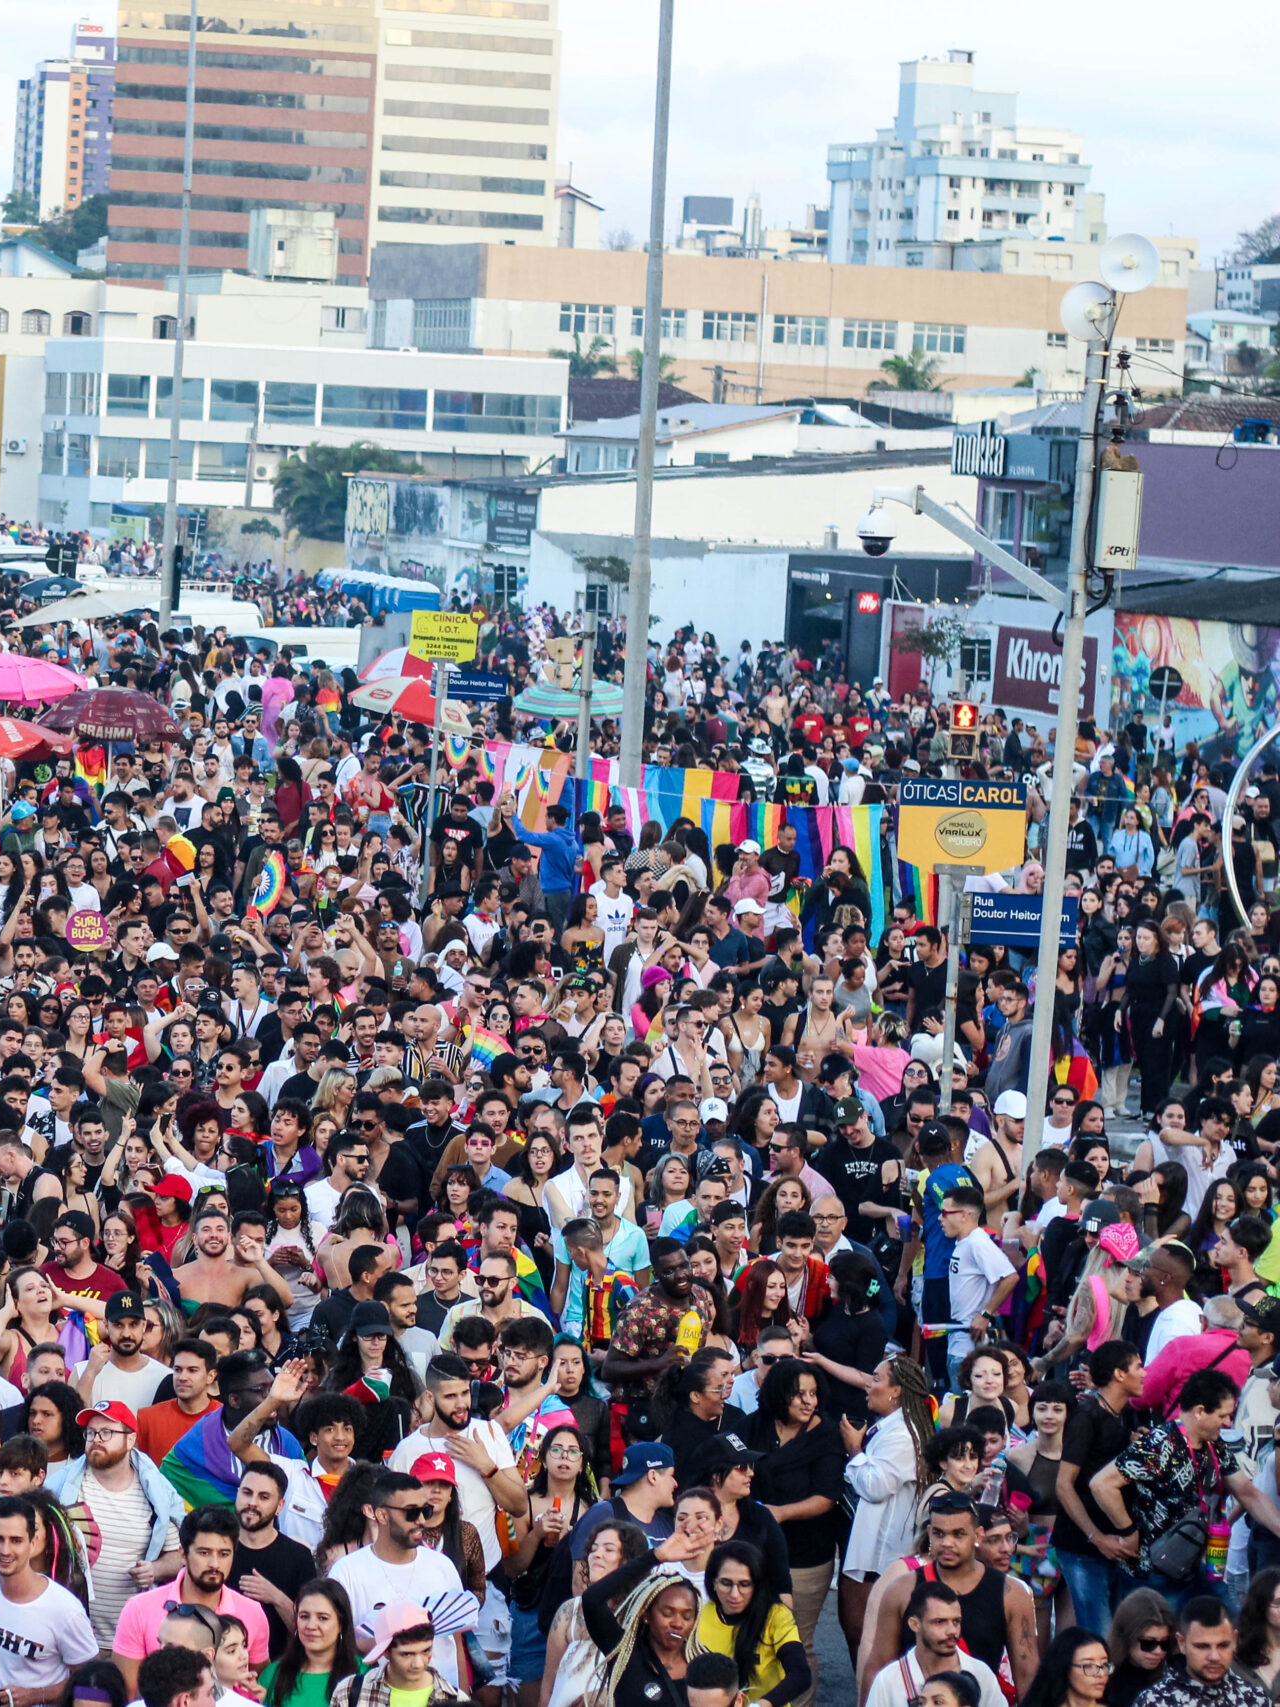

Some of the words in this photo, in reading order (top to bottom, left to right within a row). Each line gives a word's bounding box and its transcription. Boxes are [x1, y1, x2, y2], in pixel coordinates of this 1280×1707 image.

[951, 421, 1007, 477] mokka
[1008, 465, 1036, 476] FLORIPA
[1006, 636, 1088, 689] Khrons
[77, 723, 135, 741] BRAHMA
[903, 780, 958, 801] ÓTICAS
[963, 786, 1024, 805] CAROL
[974, 896, 995, 907] Rua
[74, 914, 102, 928] SURU
[973, 908, 1008, 920] Doutor
[1009, 909, 1041, 922] Heitor
[71, 927, 105, 942] BUSÃO
[607, 925, 626, 933] adidas
